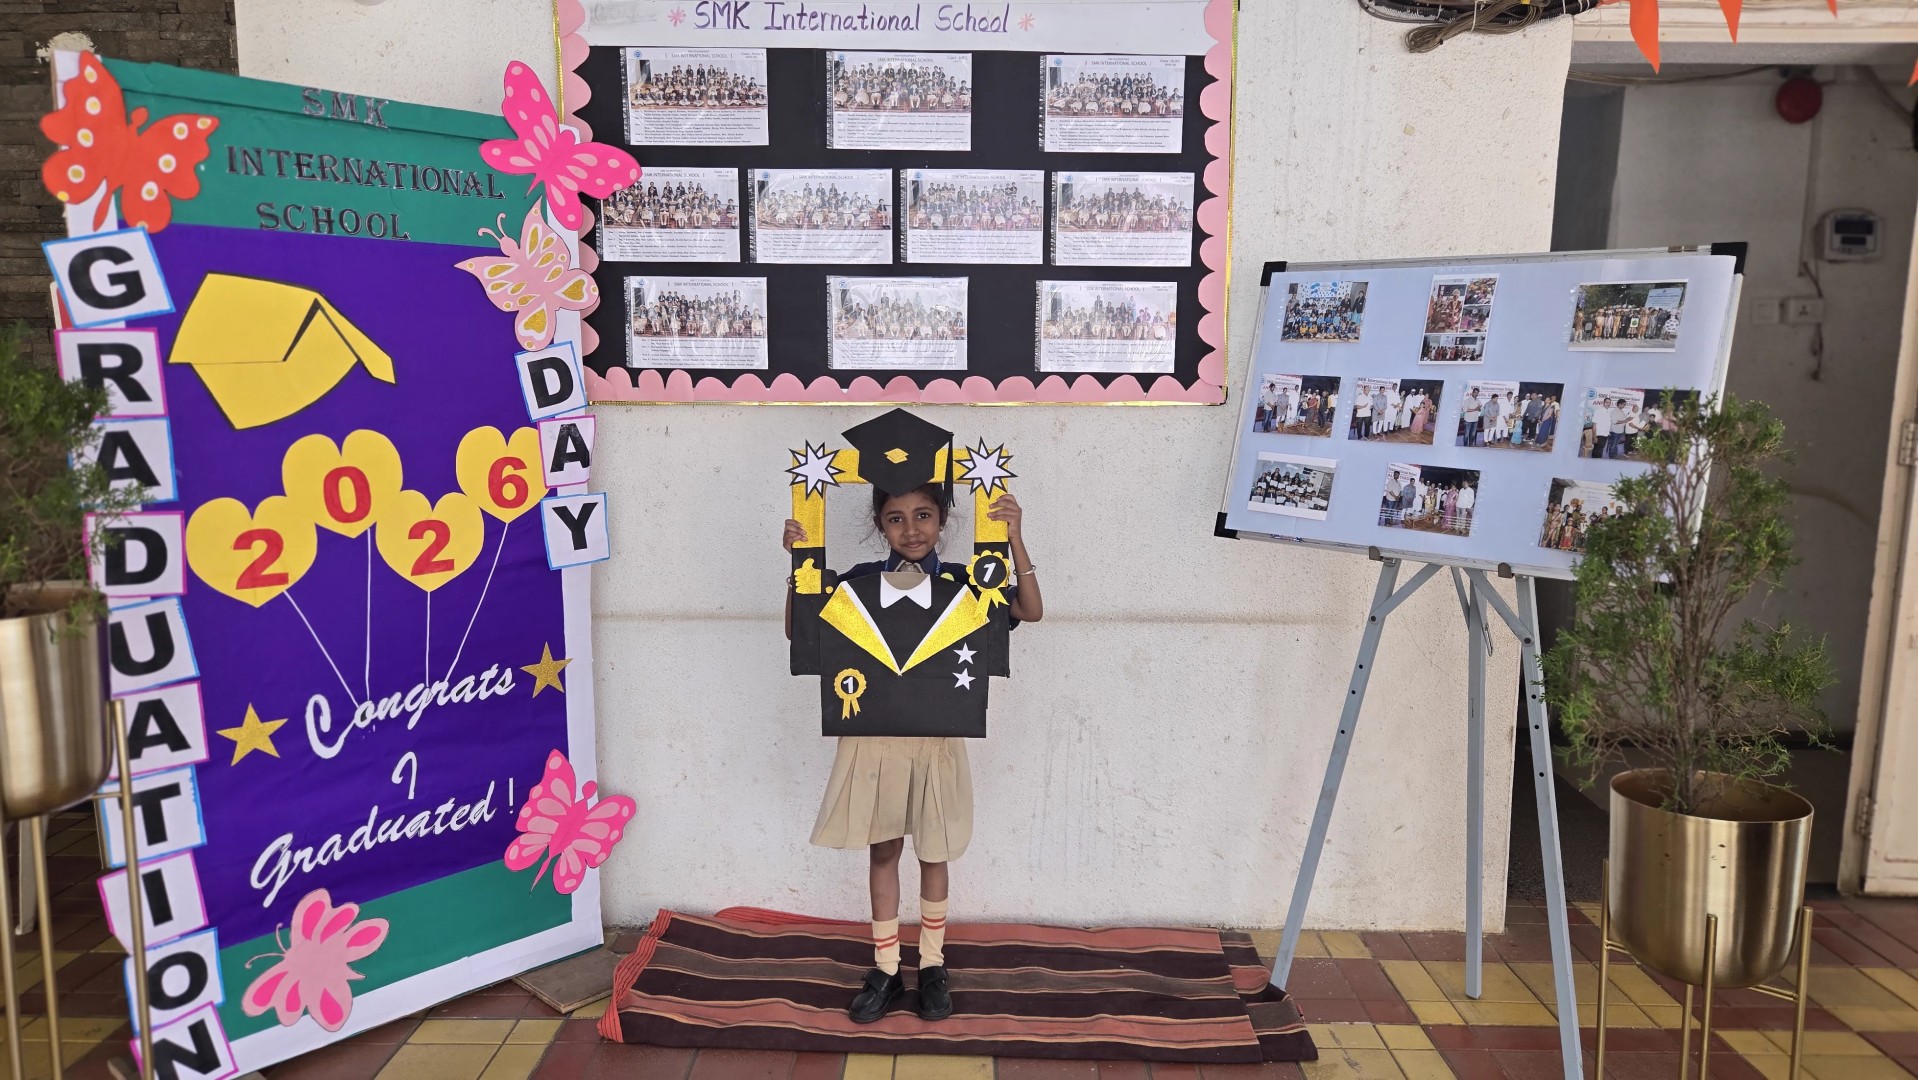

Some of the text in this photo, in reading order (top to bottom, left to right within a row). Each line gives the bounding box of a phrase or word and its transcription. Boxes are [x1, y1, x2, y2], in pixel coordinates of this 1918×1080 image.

[694, 0, 1010, 33] SMK International School
[301, 86, 389, 129] SMK
[224, 144, 506, 200] INTERNATIONAL
[255, 202, 411, 241] SCHOOL
[527, 356, 598, 551] DAY
[68, 246, 222, 1080] GRADUATION
[305, 663, 516, 759] Congrats
[391, 751, 418, 800] I
